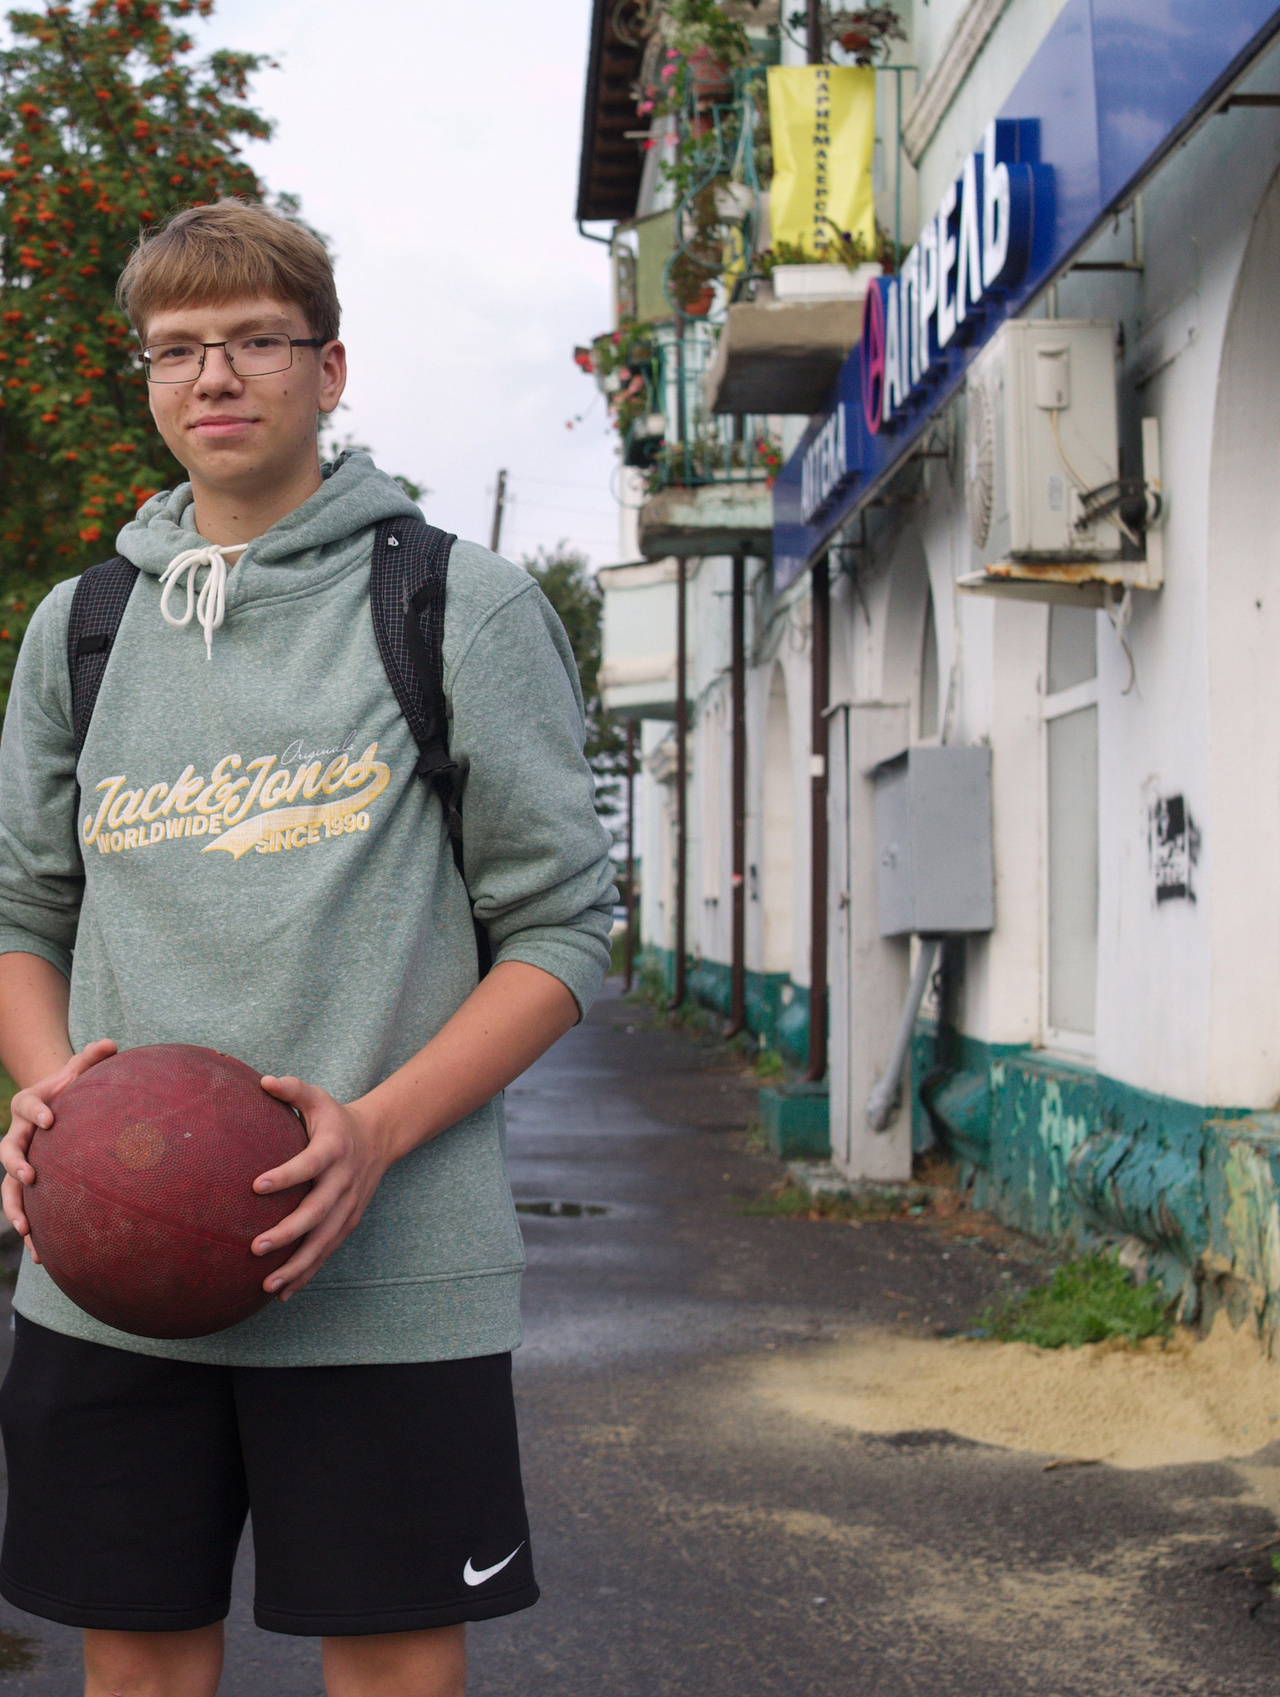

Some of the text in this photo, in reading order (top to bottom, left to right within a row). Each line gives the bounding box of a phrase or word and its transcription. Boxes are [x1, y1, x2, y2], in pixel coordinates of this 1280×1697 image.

[882, 118, 1010, 422] АПРЕЛЬ
[801, 401, 847, 525] АПТЕКА
[96, 811, 370, 855] WORLDWIDE SINCE 1990
